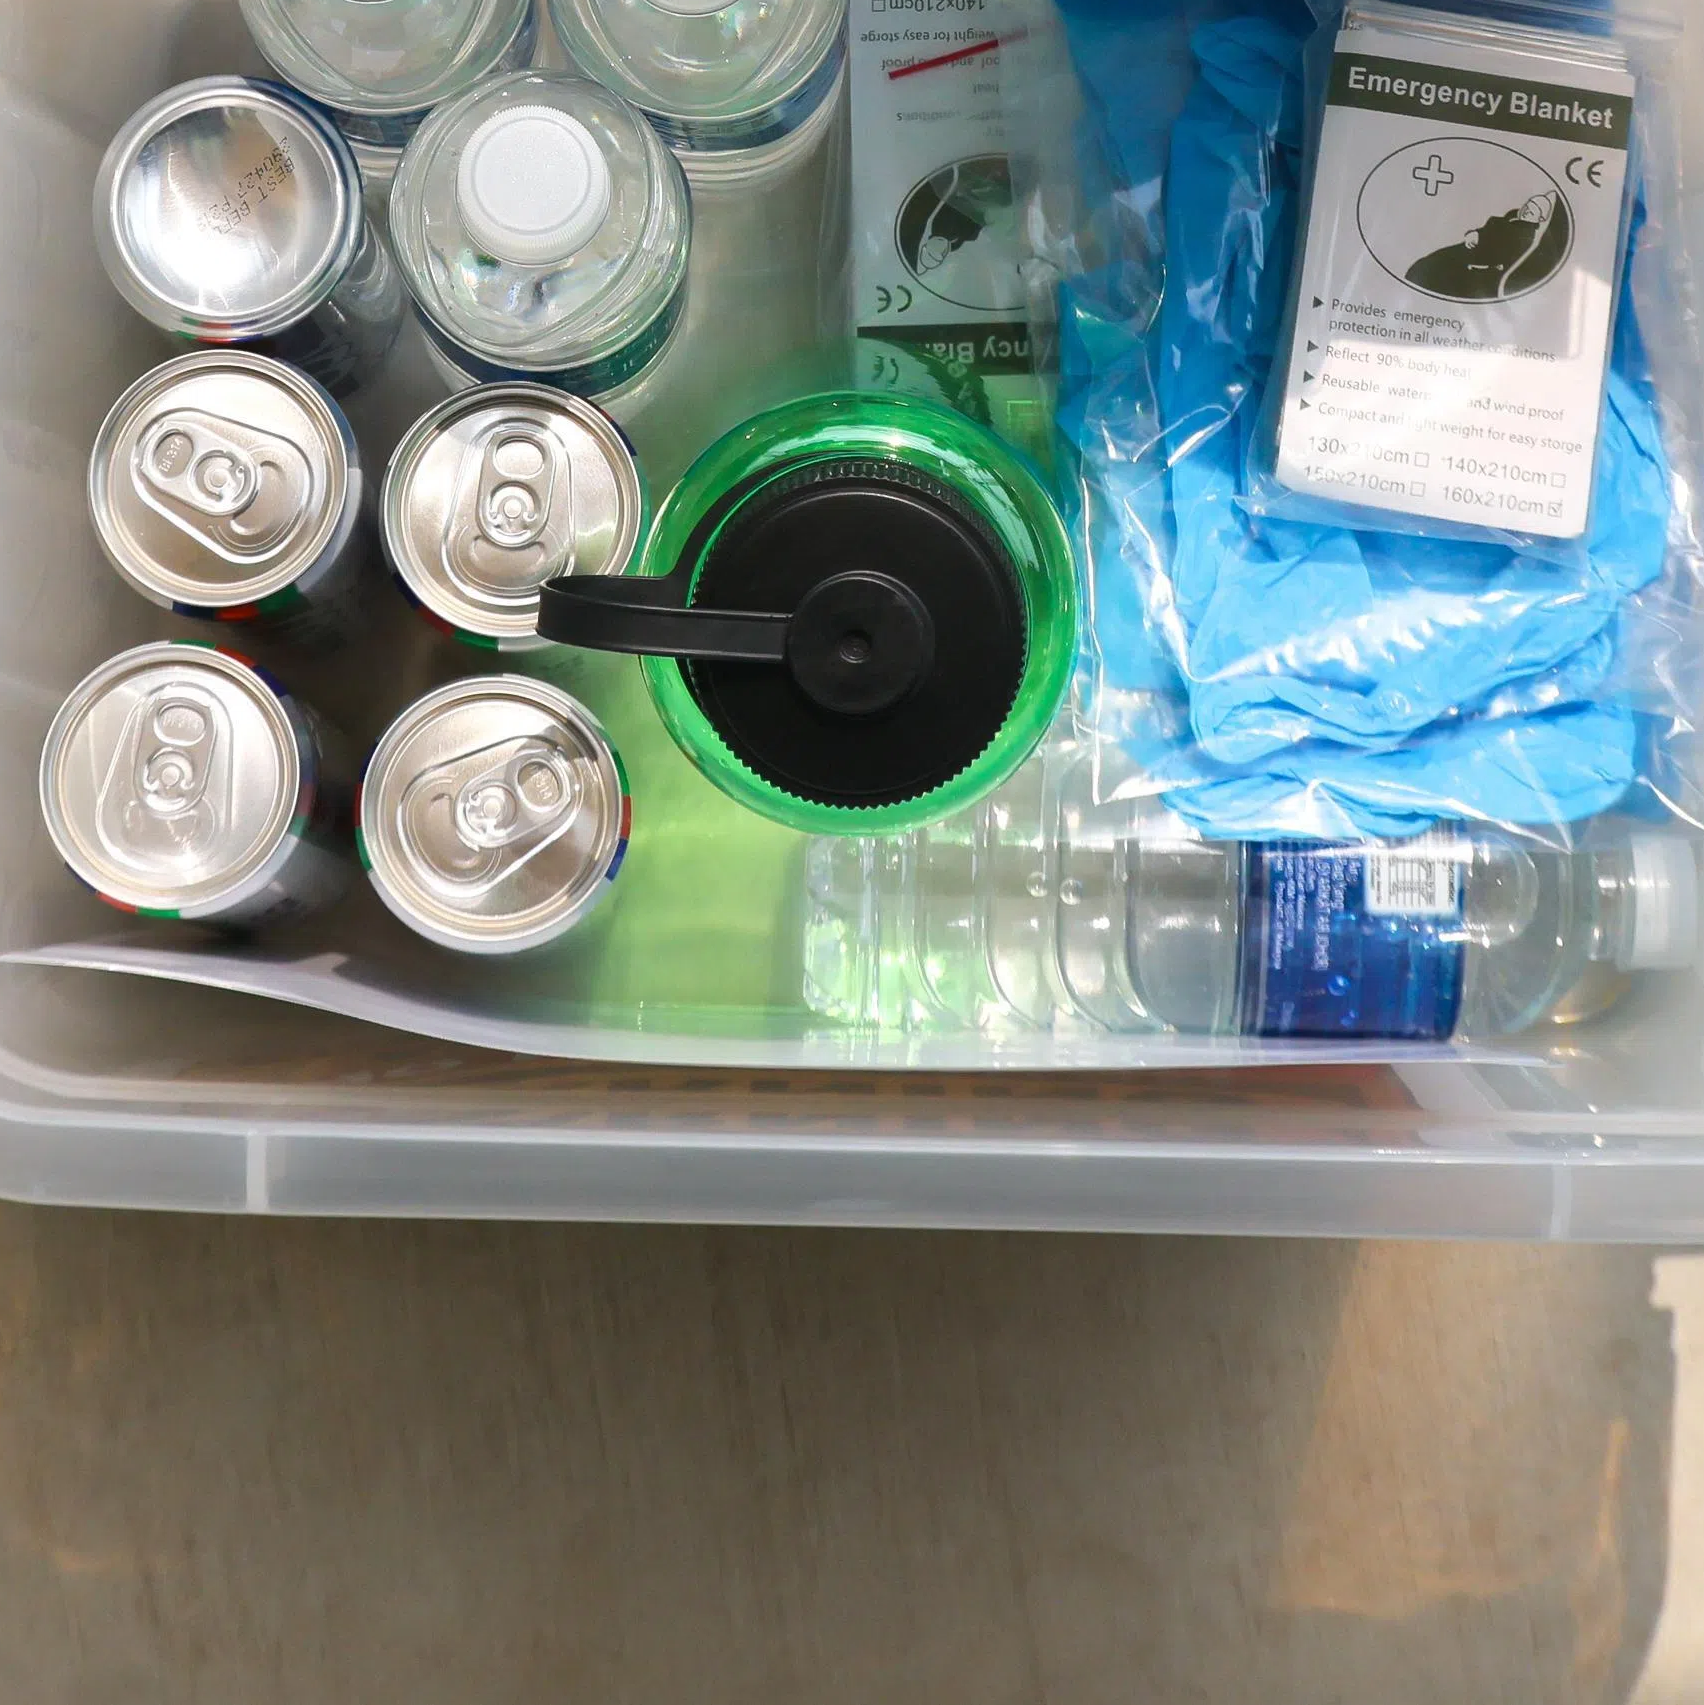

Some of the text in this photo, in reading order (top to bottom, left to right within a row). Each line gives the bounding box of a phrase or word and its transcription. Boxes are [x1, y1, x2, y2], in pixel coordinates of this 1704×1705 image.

[861, 32, 899, 41] storge
[903, 29, 929, 41] easy
[933, 31, 950, 41] for
[1348, 66, 1614, 130] Emergency Blanket
[255, 157, 295, 204] BEST
[1332, 299, 1465, 331] Provides emergency
[1329, 320, 1396, 339] protection
[1400, 328, 1411, 340] in
[1415, 330, 1429, 343] all
[1433, 335, 1484, 353] weather
[1325, 346, 1370, 364] Reflect
[1377, 353, 1404, 368] 90%
[1408, 359, 1440, 376] body
[1322, 374, 1380, 394] Reusable
[1528, 407, 1563, 422] proof
[1318, 402, 1377, 426] Compact
[1440, 424, 1483, 439] weight
[1487, 427, 1506, 441] for
[1509, 432, 1538, 449] easy
[1541, 437, 1582, 454] storge
[1445, 457, 1547, 485] 140x210cm
[1443, 487, 1543, 515] 160x210cm
